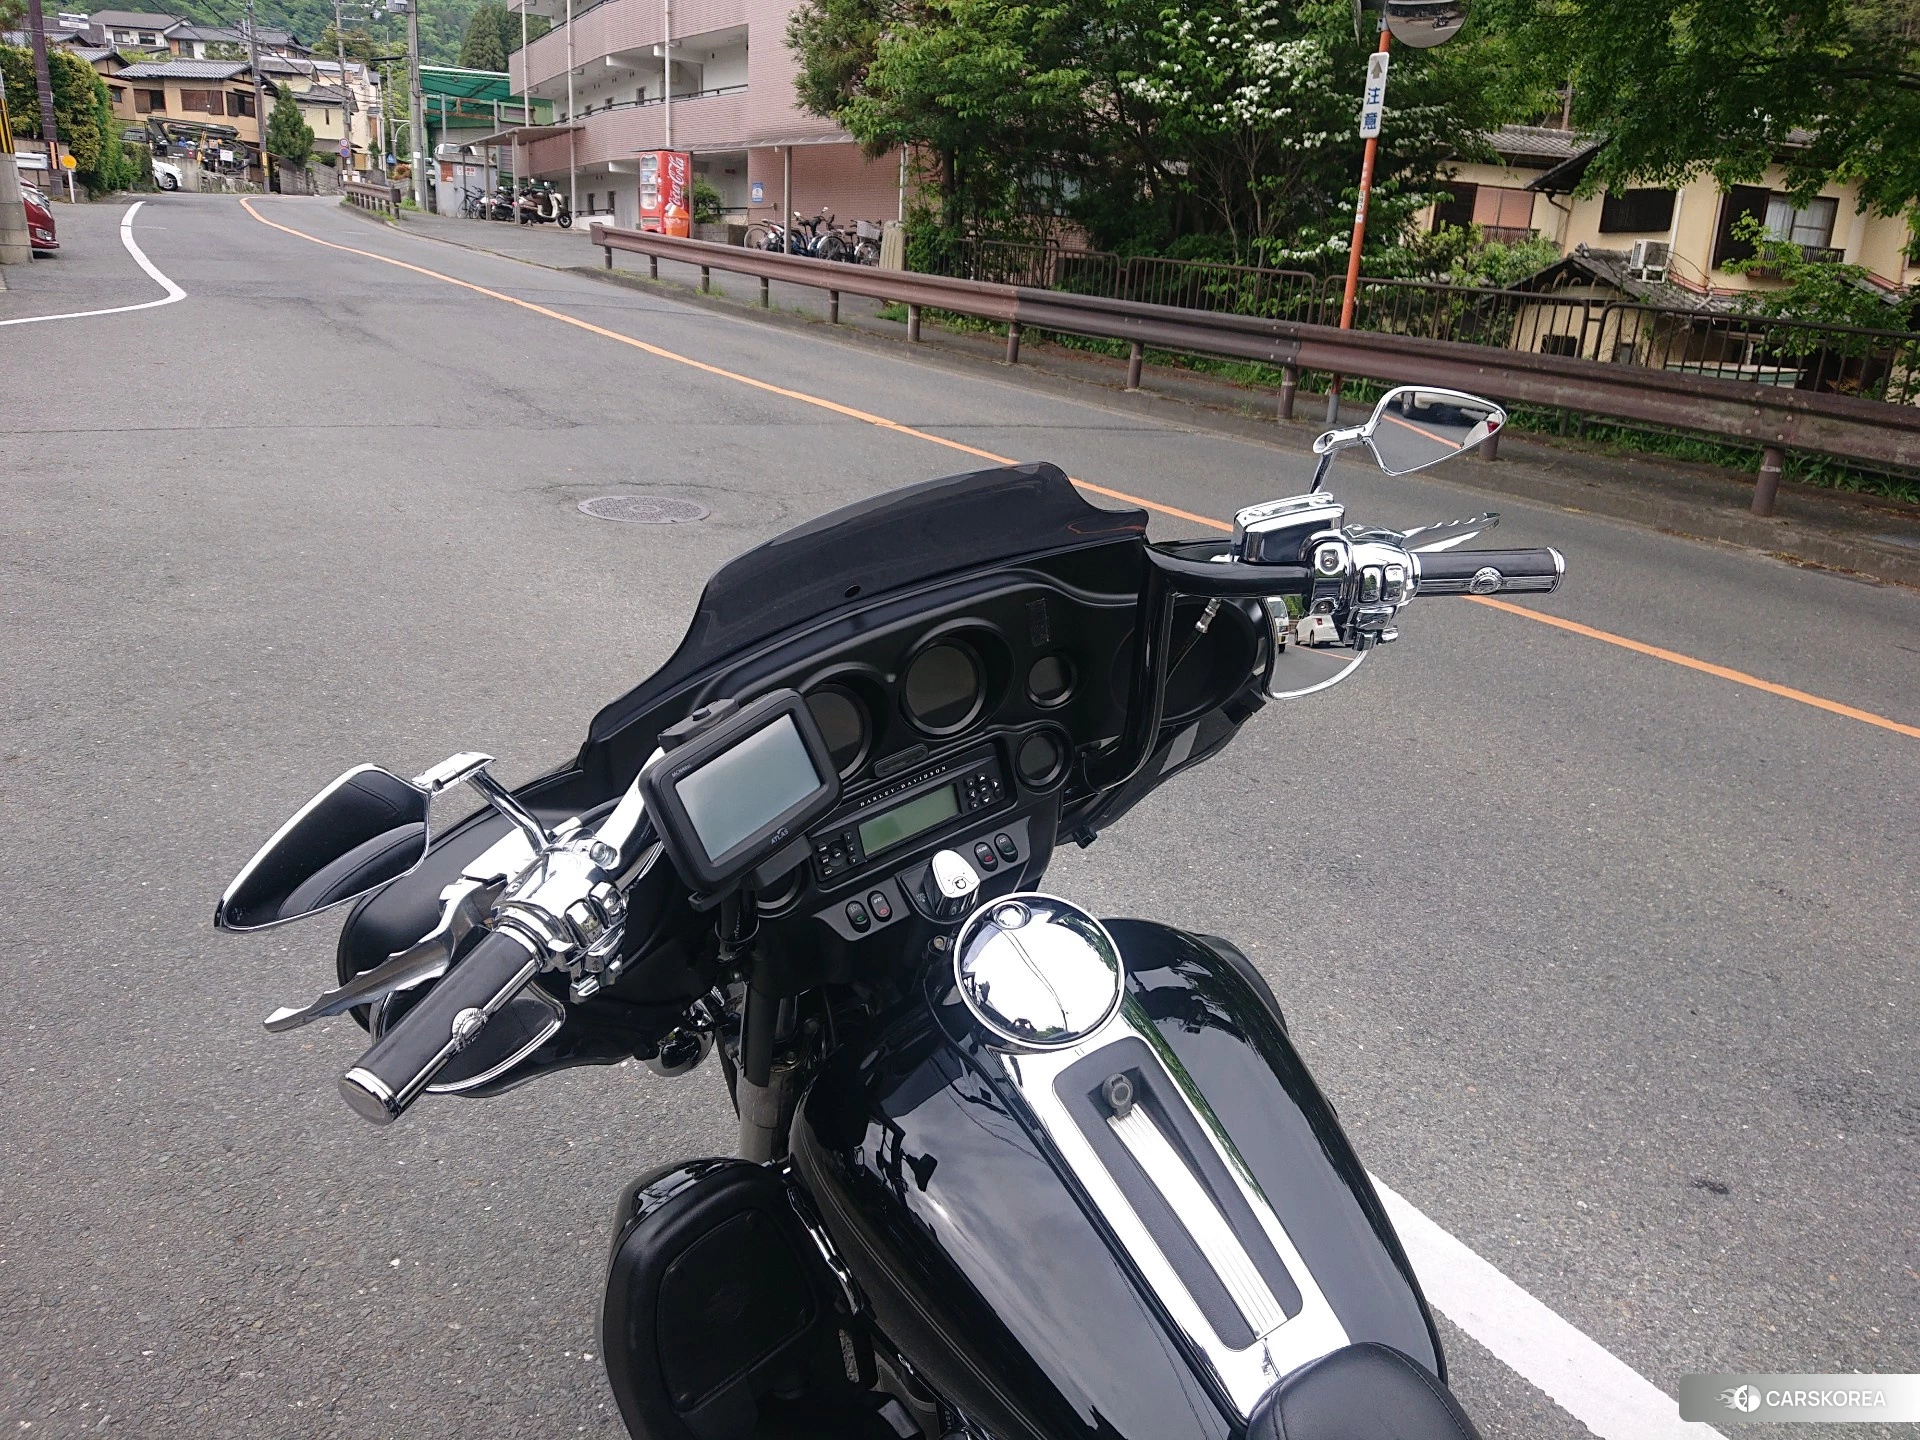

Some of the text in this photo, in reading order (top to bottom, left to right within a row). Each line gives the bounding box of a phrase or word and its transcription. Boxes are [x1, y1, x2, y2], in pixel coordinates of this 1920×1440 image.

[1362, 87, 1381, 130] 注意
[860, 765, 947, 807] HARLEY-DAVIDSON
[771, 828, 789, 845] ATLAS
